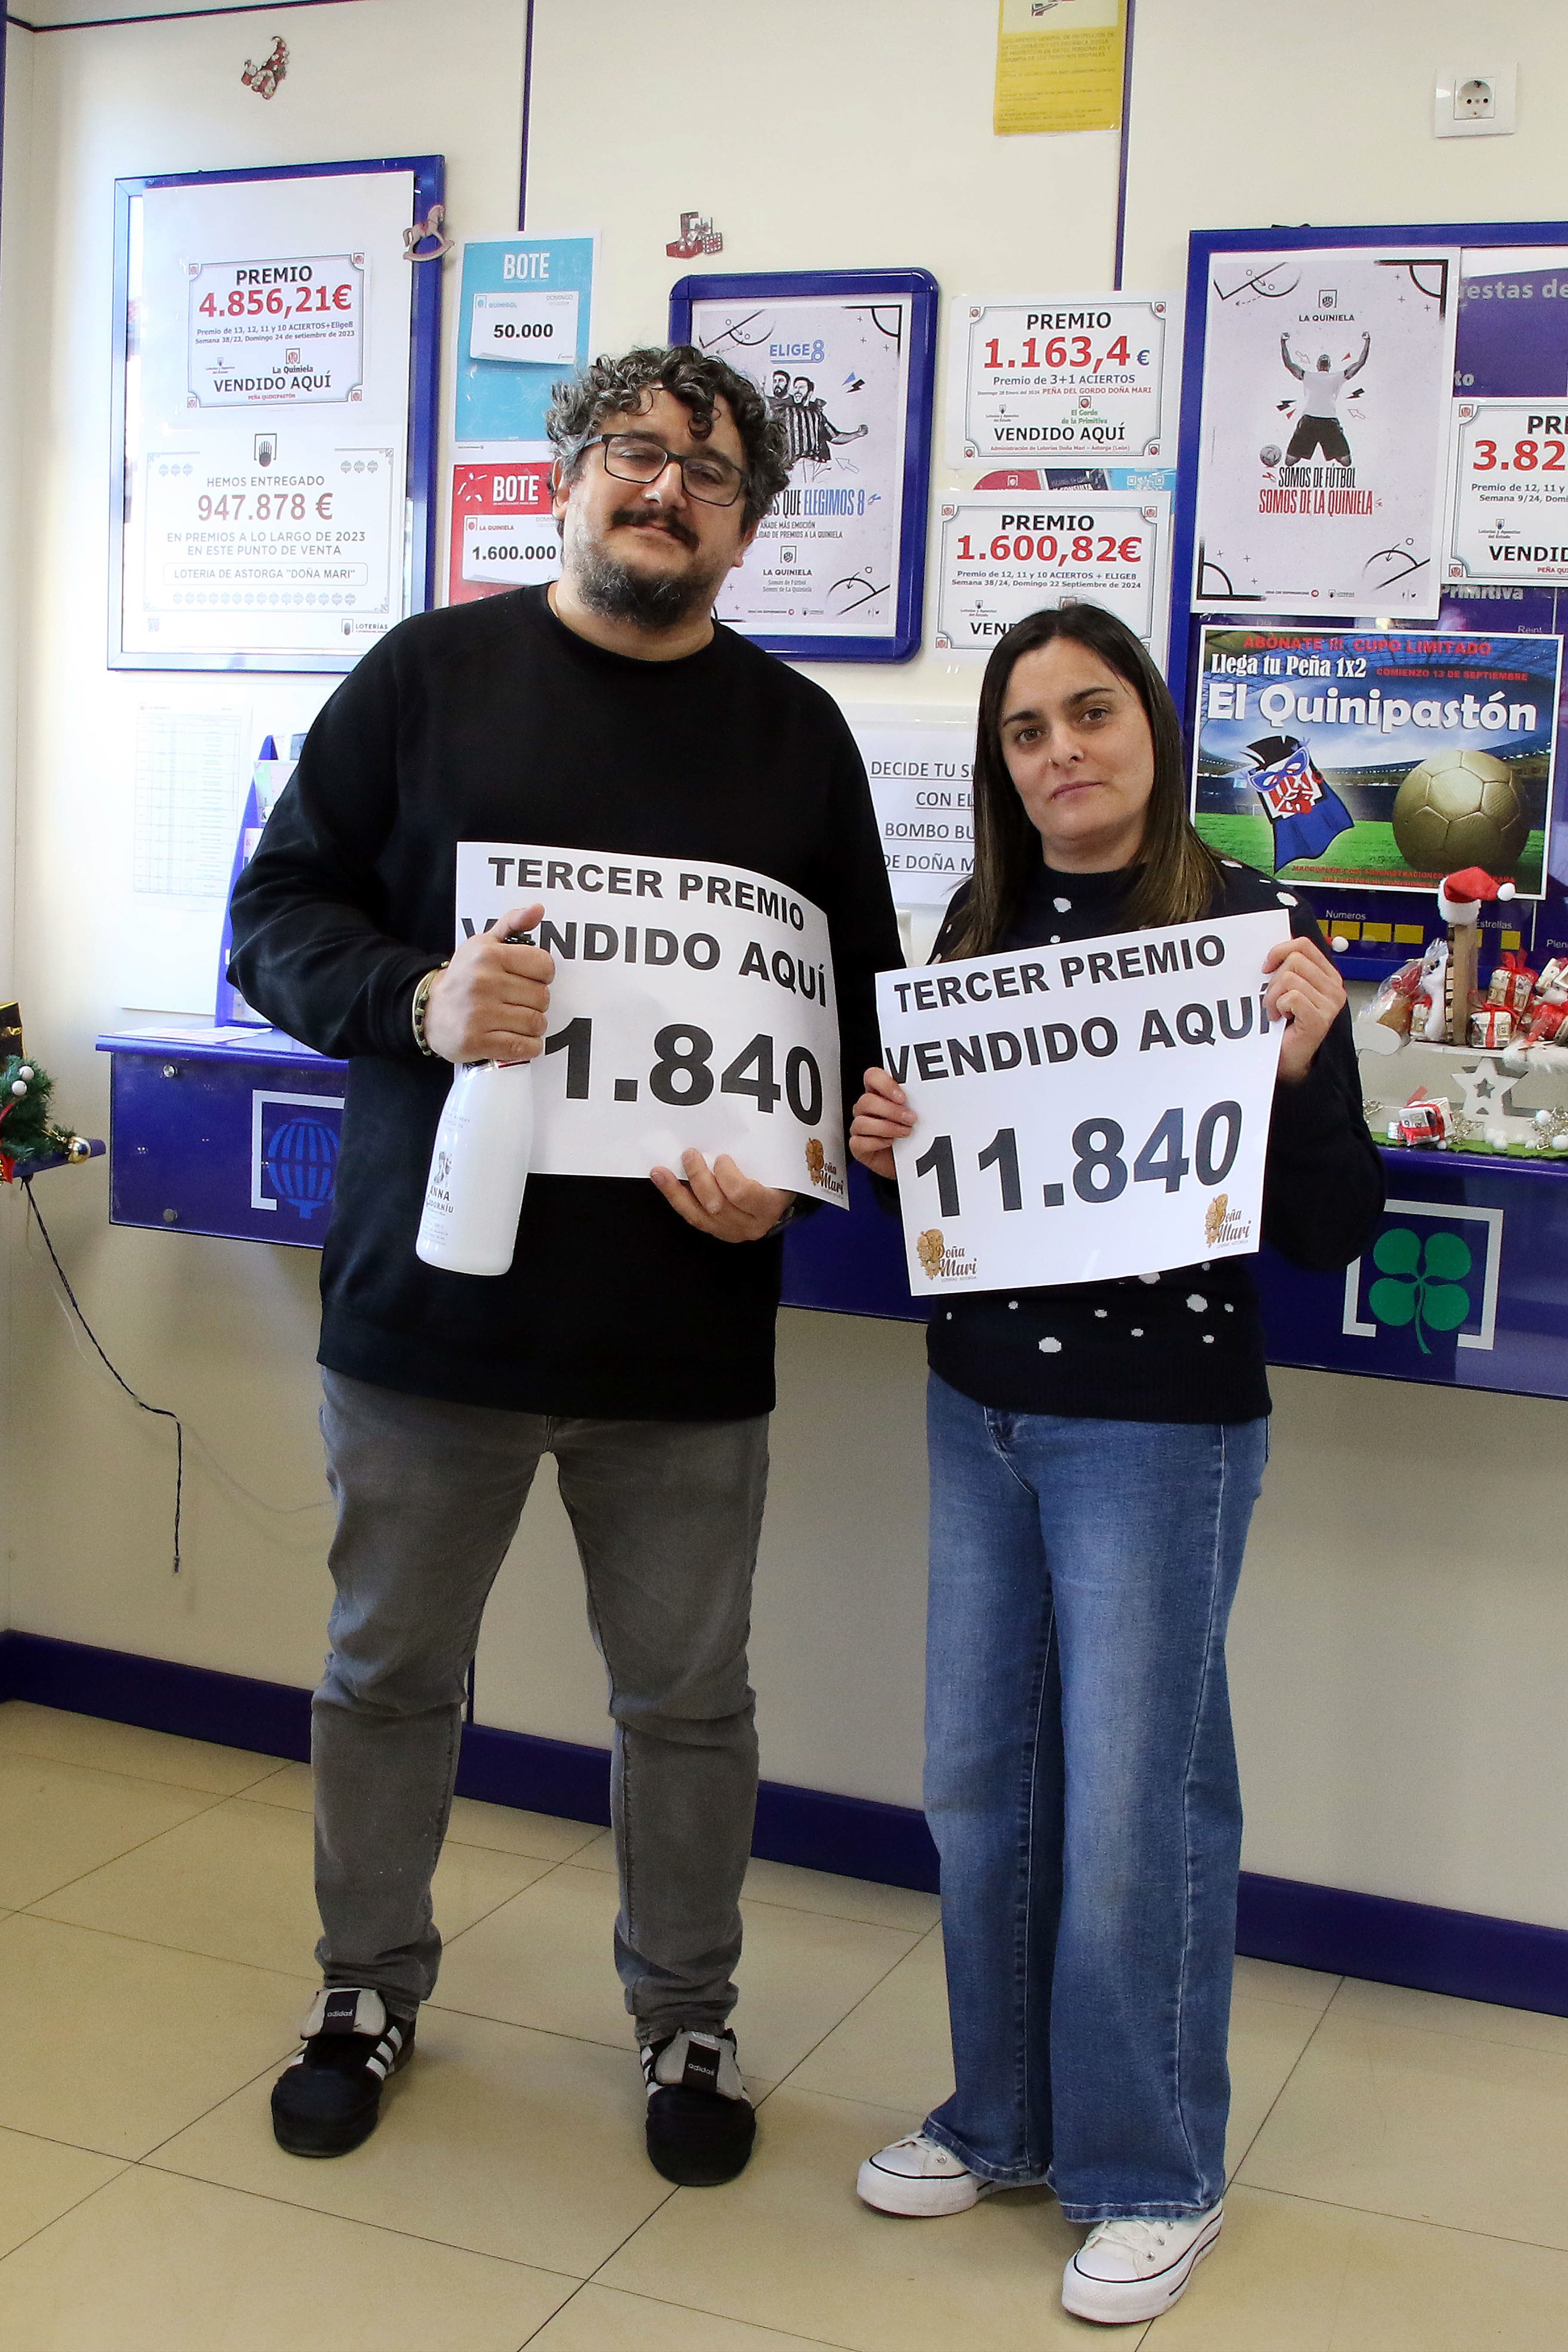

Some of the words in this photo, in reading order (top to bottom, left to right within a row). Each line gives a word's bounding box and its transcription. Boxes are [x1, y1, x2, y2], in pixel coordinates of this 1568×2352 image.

[236, 266, 312, 285] PREMIO
[503, 252, 550, 280] BOTE
[199, 284, 352, 319] 4.856,21€
[1027, 312, 1111, 330] PREMIO
[234, 327, 245, 335] 13,
[494, 324, 554, 338] 50.000
[770, 340, 825, 362] ELIGE8
[984, 336, 1130, 374] 1.163,4
[1137, 349, 1150, 366] €
[284, 365, 313, 373] Quiniela
[214, 377, 286, 392] VENDIDO
[291, 371, 331, 392] AQUÍ
[993, 376, 1030, 385] Premio
[1034, 375, 1047, 385] de
[1050, 374, 1075, 385] 3+1
[1079, 374, 1136, 384] ACIERTOS
[1108, 386, 1130, 394] DOÑA
[994, 427, 1074, 441] VENDIDO
[1081, 422, 1125, 443] AQUÍ
[207, 477, 247, 487] HEMOS
[251, 476, 325, 487] ENTREGADO
[1278, 467, 1311, 487] SOMOS
[1314, 467, 1323, 487] DE
[1326, 463, 1356, 488] FÚTBOL
[493, 475, 540, 502] BOTE
[198, 493, 306, 521] 947.878
[315, 492, 333, 521] €
[783, 490, 802, 518] QUE
[804, 489, 855, 516] ELEGIMOS
[1259, 490, 1297, 514] SOMOS
[1299, 490, 1311, 514] DE
[1314, 490, 1325, 514] LA
[1329, 490, 1373, 517] QUINIELA
[1001, 515, 1094, 531] PREMIO
[167, 533, 182, 542] EN
[185, 533, 236, 542] PREMIOS
[239, 533, 247, 542] A
[250, 532, 266, 542] LO
[270, 532, 311, 542] LARGO
[316, 532, 331, 541] DE
[335, 531, 365, 542] 2023
[187, 546, 202, 556] EN
[206, 546, 234, 555] ESTE
[237, 546, 277, 555] PUNTO
[281, 546, 296, 555] DE
[300, 545, 341, 555] VENTA
[472, 546, 557, 560] 1.600.000
[957, 536, 1142, 567] 1.600,82€
[175, 570, 215, 579] LOTERIA
[219, 570, 232, 578] DE
[235, 569, 283, 578] ASTORGA
[1243, 636, 1323, 649] ABÓNATE
[1353, 639, 1401, 652] CUPO
[1406, 640, 1491, 655] LIMITADO
[1211, 653, 1258, 676] Llega
[1264, 655, 1280, 675] tu
[1286, 654, 1331, 677] Peña
[1336, 657, 1367, 677] 1x2
[1376, 668, 1430, 677] COMIENZO
[1464, 671, 1528, 680] SEPTIEMBRE
[1207, 683, 1246, 720] El
[1260, 683, 1536, 733] Quinipastón
[871, 761, 928, 776] DECIDE
[934, 763, 955, 777] TU
[916, 792, 951, 806] CON
[885, 823, 949, 838] BOMBO
[906, 852, 955, 871] DOÑA
[488, 857, 662, 898] TERCER
[679, 873, 805, 931] PREMIO
[461, 918, 720, 970] VNDIDO
[739, 941, 826, 1007] AQUÍ
[894, 963, 1049, 1012] TERCER
[1060, 934, 1225, 988] PREMIO
[886, 1018, 1118, 1084] VENDIDO
[1139, 983, 1271, 1051] AQUÍ
[544, 1017, 823, 1126] 1.840
[916, 1100, 1242, 1218] 11.840
[430, 1185, 449, 1201] ANNA
[1218, 1220, 1252, 1243] Mari
[939, 1258, 977, 1277] Mari
[327, 2009, 353, 2017] adidas
[688, 2063, 715, 2076] adidas
